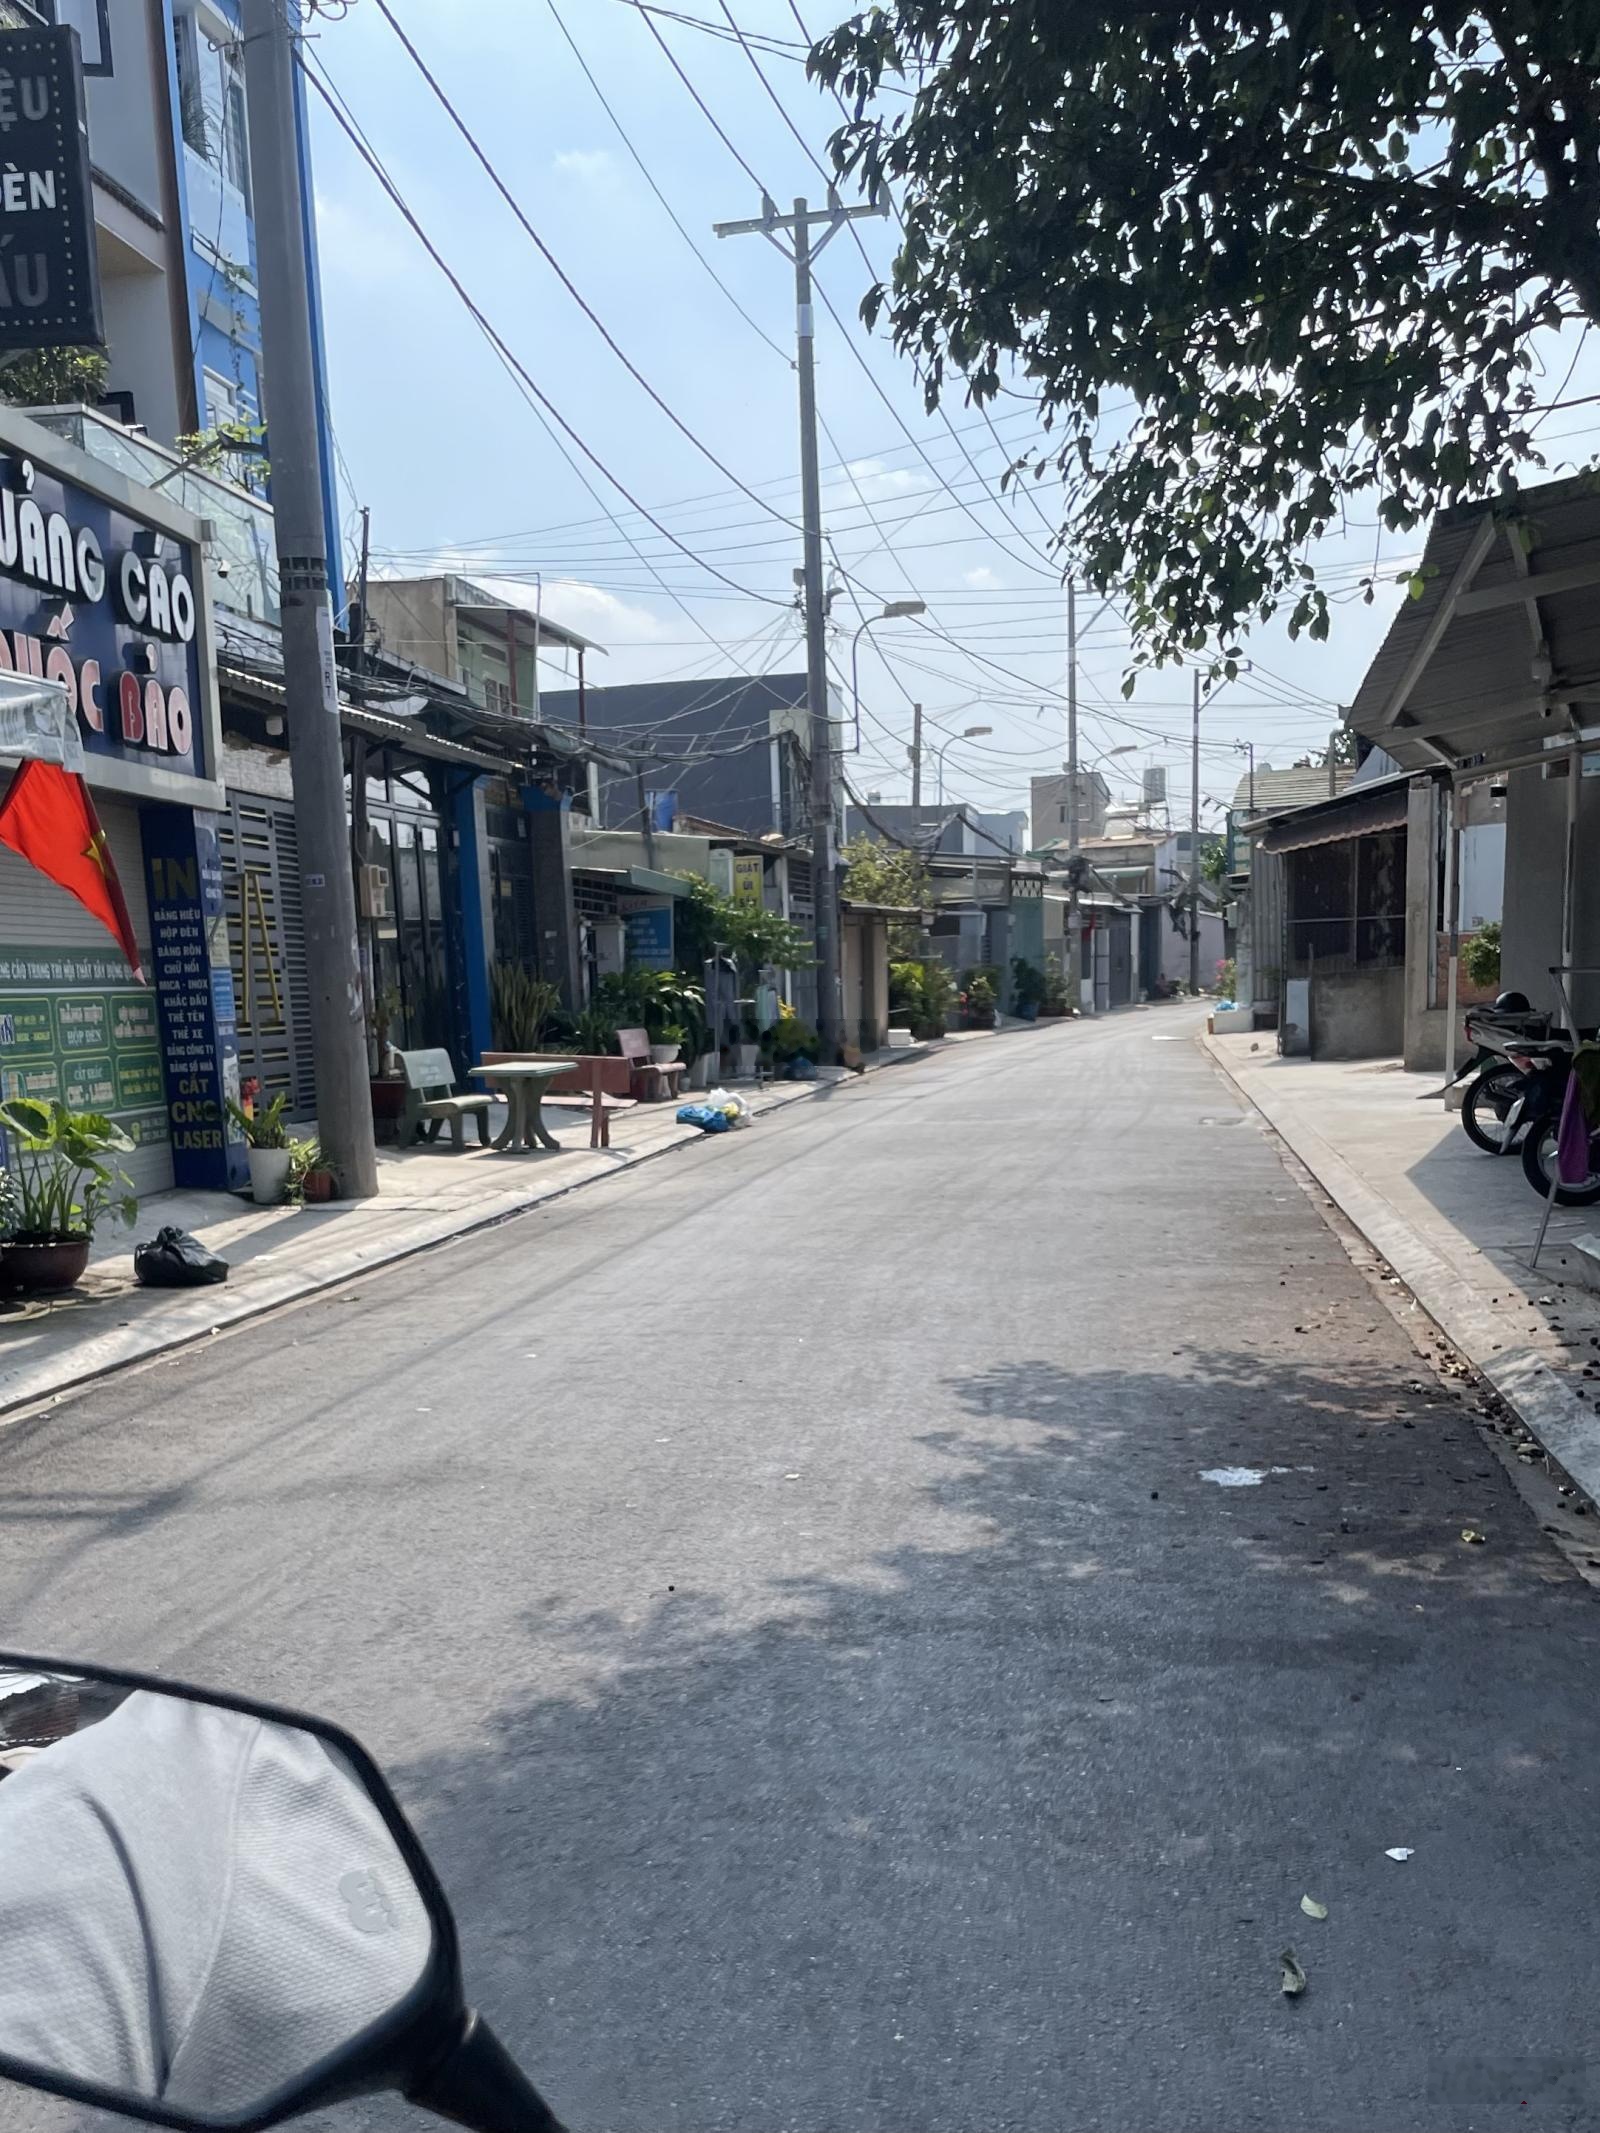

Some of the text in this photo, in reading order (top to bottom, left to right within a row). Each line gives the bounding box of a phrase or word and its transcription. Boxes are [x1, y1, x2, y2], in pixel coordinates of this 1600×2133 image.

[0, 162, 57, 212] ÈN
[121, 532, 196, 642] CÁO
[120, 643, 192, 755] BẢO
[152, 856, 197, 899] IN
[188, 979, 208, 990] INOX
[192, 1028, 204, 1039] XE
[173, 1129, 223, 1149] LASER
